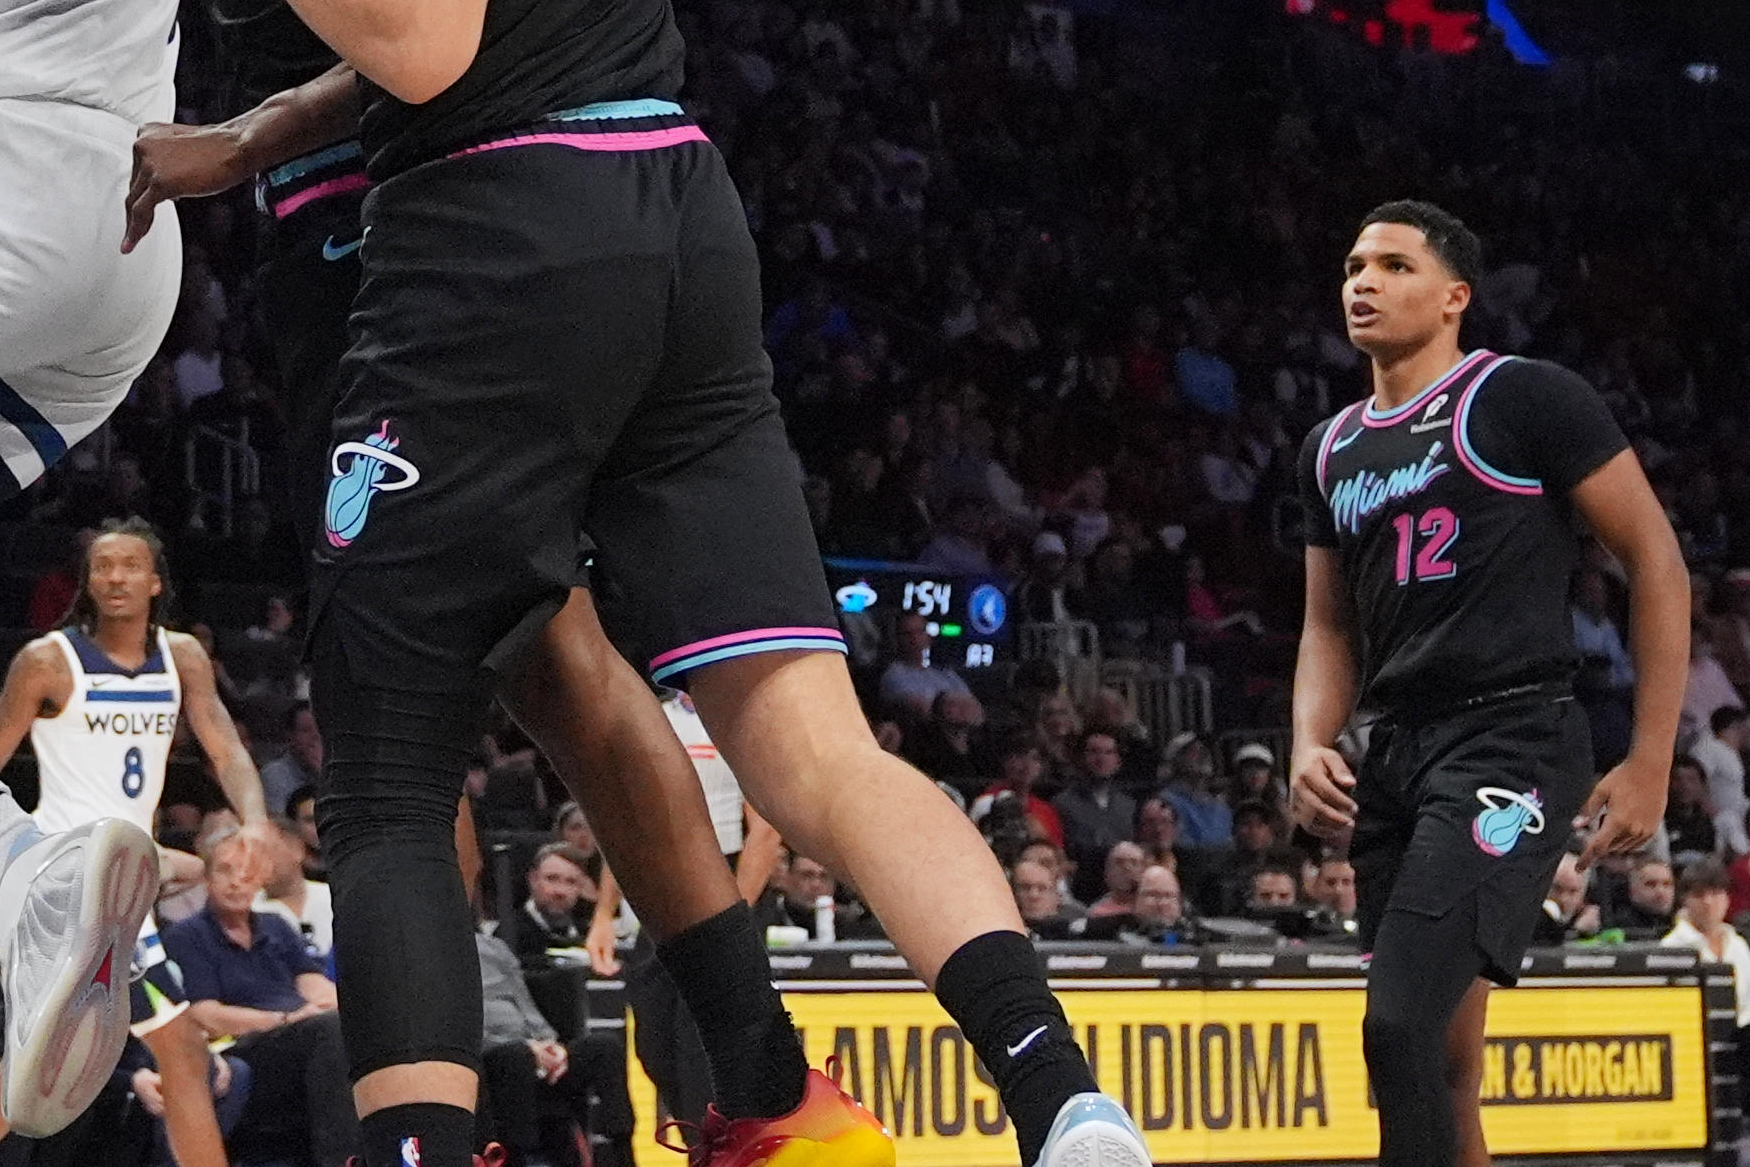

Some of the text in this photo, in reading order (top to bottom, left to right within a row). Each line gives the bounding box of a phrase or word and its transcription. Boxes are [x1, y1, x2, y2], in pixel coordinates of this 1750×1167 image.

[1330, 440, 1450, 535] Miami
[1392, 506, 1460, 586] 12
[121, 745, 144, 799] 8
[1120, 1021, 1329, 1131] IDIOMA
[1511, 1041, 1536, 1100] &
[1539, 1039, 1663, 1099] MORGAN
